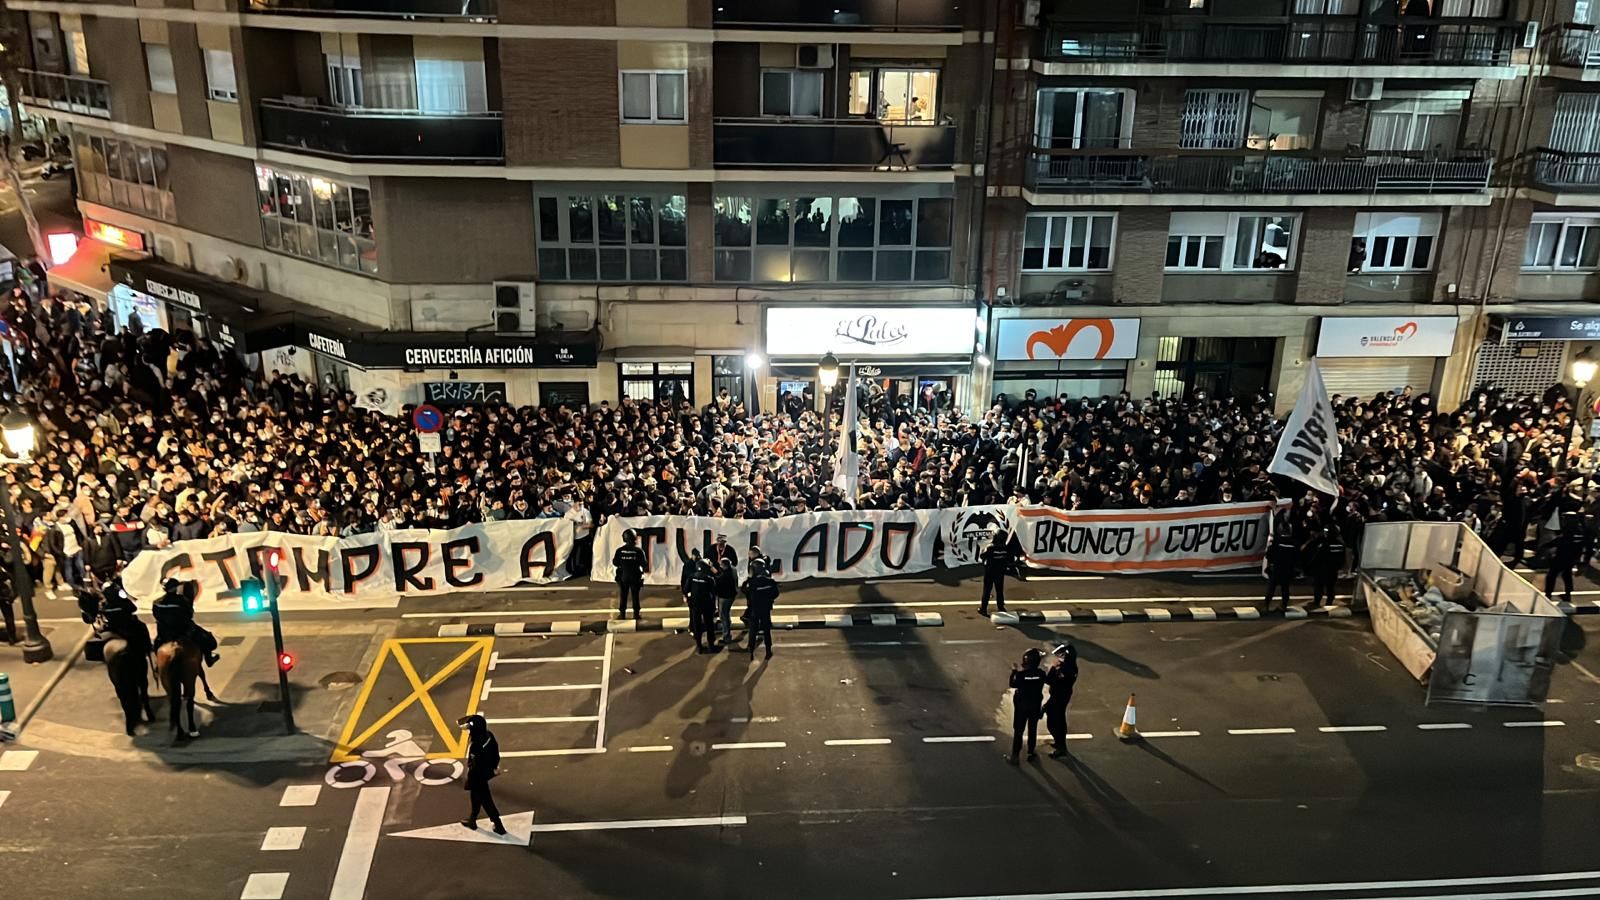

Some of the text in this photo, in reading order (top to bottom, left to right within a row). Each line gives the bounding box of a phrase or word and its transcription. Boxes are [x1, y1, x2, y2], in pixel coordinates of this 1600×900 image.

[1571, 320, 1584, 330] Se
[308, 332, 347, 359] CAFETERÍA
[405, 346, 534, 364] CERVECERÍA AFICIÓN
[1033, 518, 1260, 557] BRONCO Y COPERO
[519, 530, 557, 578] A
